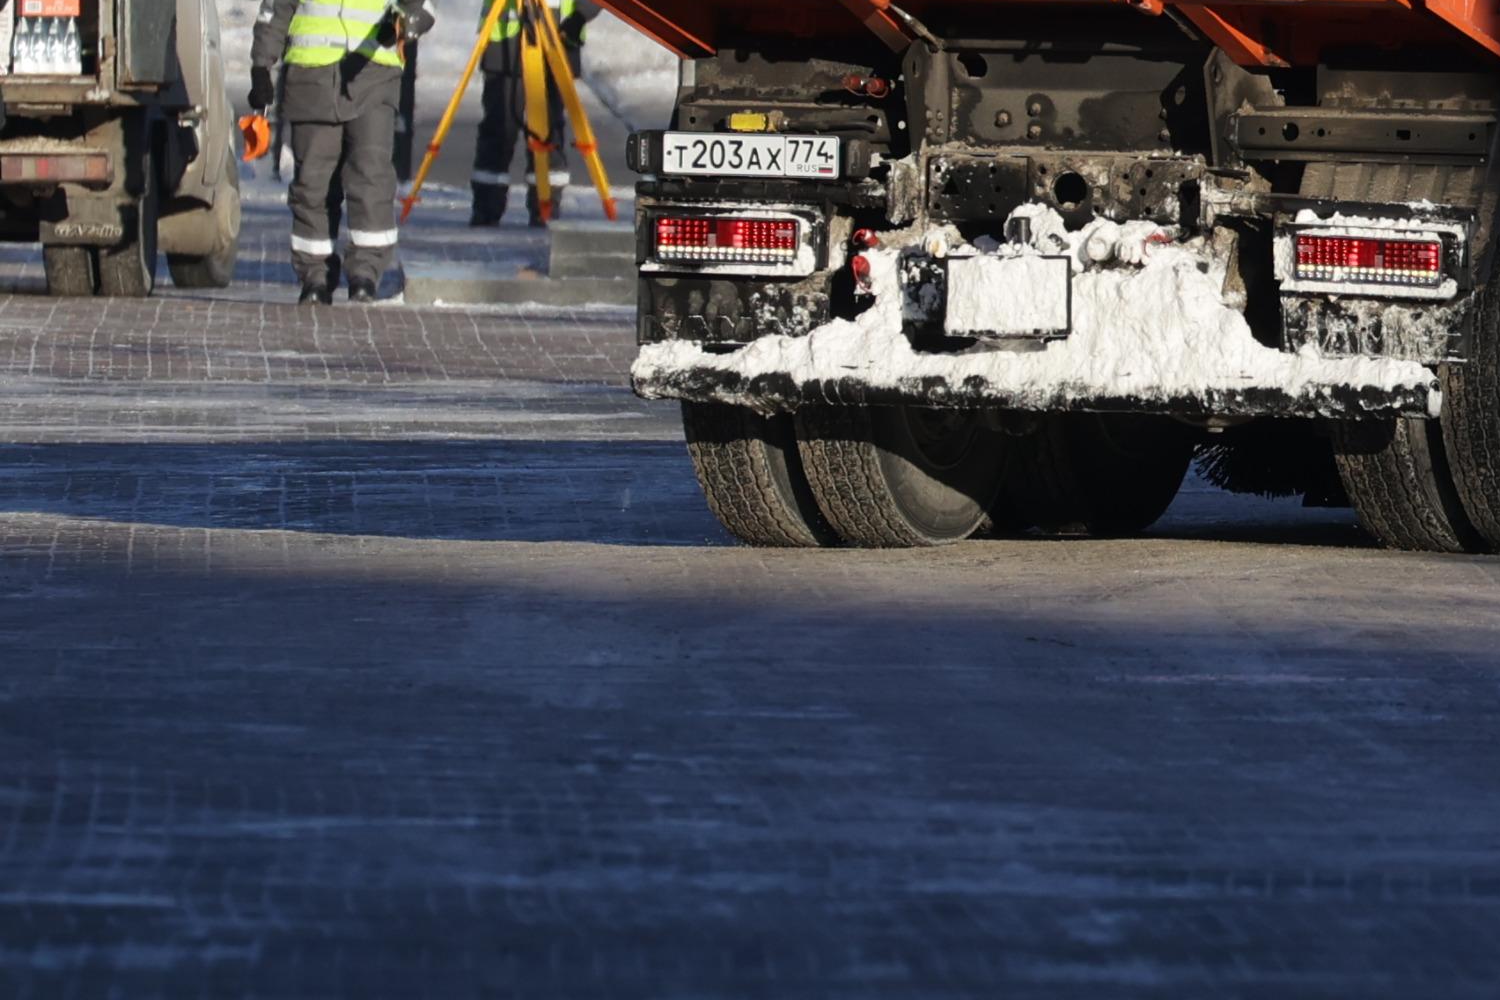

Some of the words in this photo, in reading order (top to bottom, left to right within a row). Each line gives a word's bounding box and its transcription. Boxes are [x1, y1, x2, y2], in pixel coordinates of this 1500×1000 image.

[674, 139, 782, 171] Т203АХ
[788, 140, 830, 163] 774
[796, 164, 818, 173] RUS
